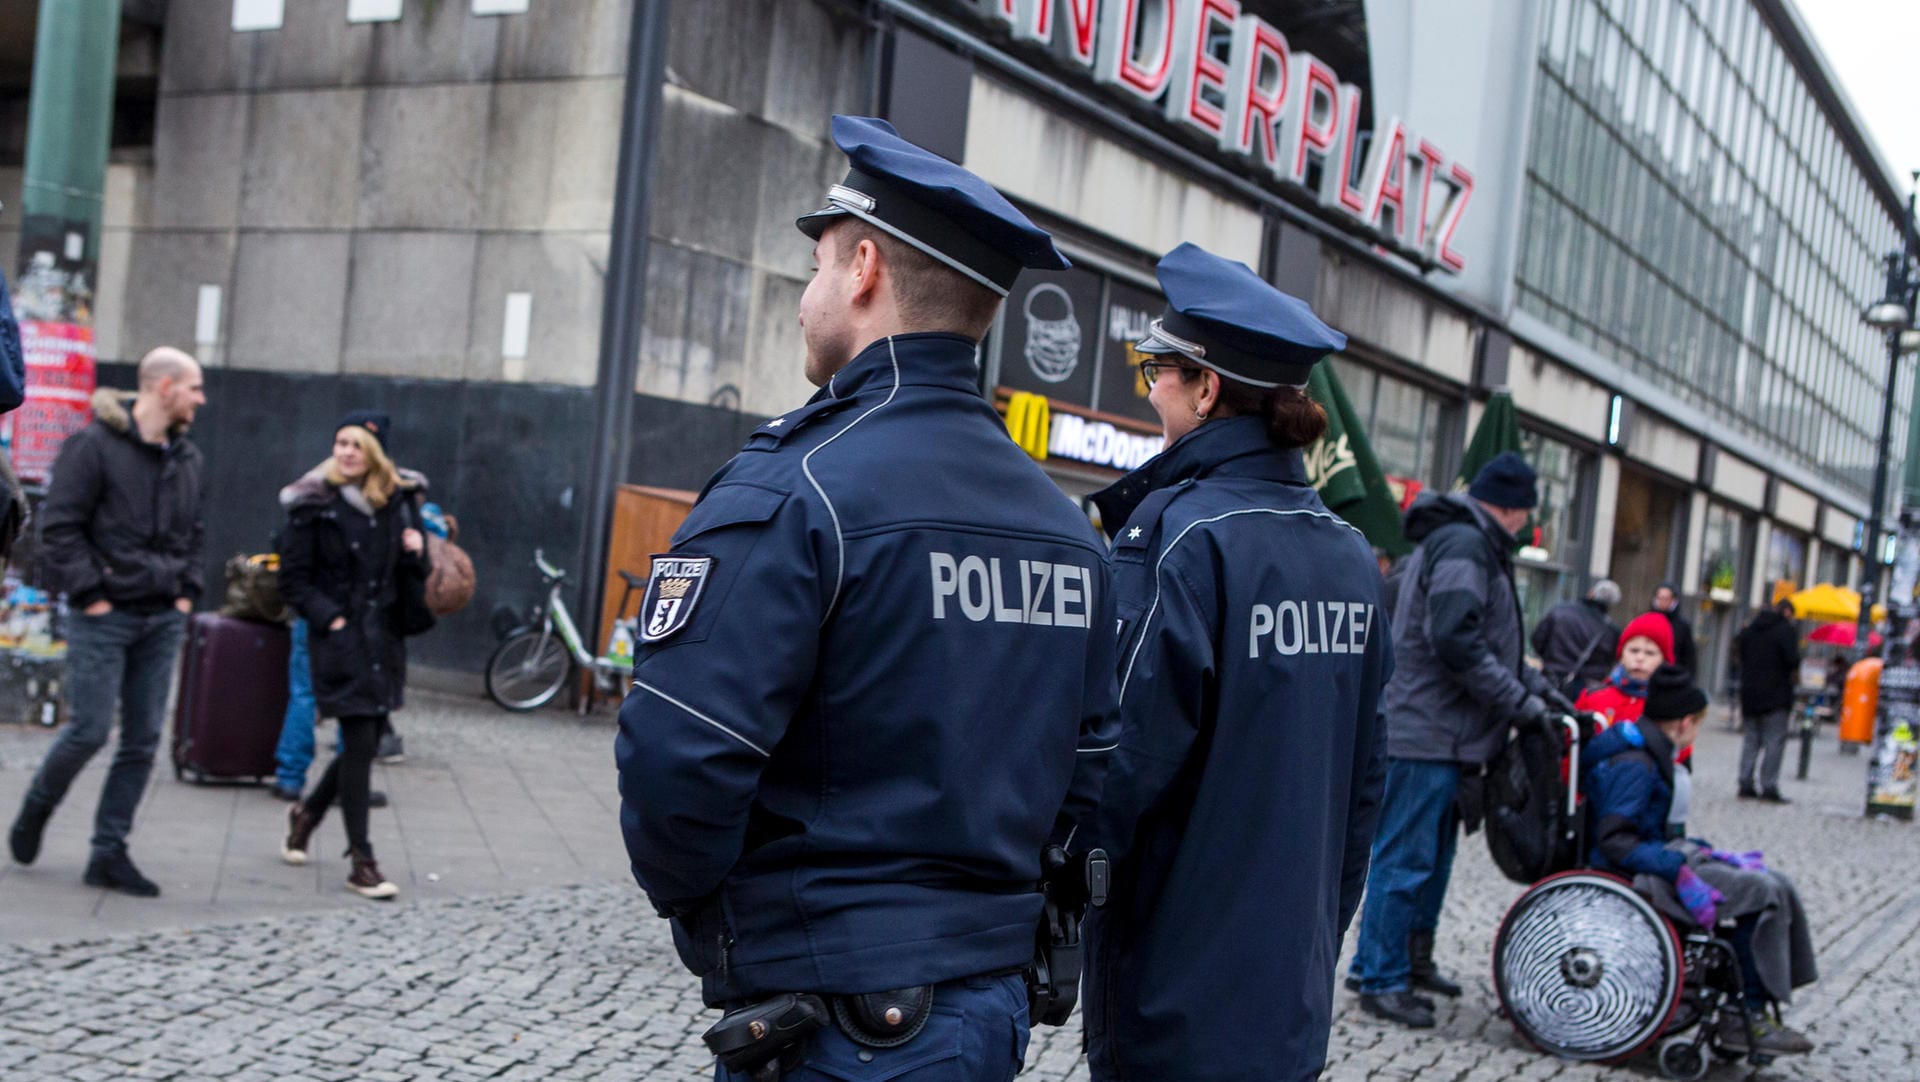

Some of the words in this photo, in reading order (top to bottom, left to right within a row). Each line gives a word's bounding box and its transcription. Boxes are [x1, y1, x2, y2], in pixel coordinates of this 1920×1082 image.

[984, 0, 1476, 273] DERPLATZ
[1049, 412, 1166, 470] McDona
[930, 552, 1092, 628] POLIZEI
[1249, 600, 1375, 658] POLIZEI
